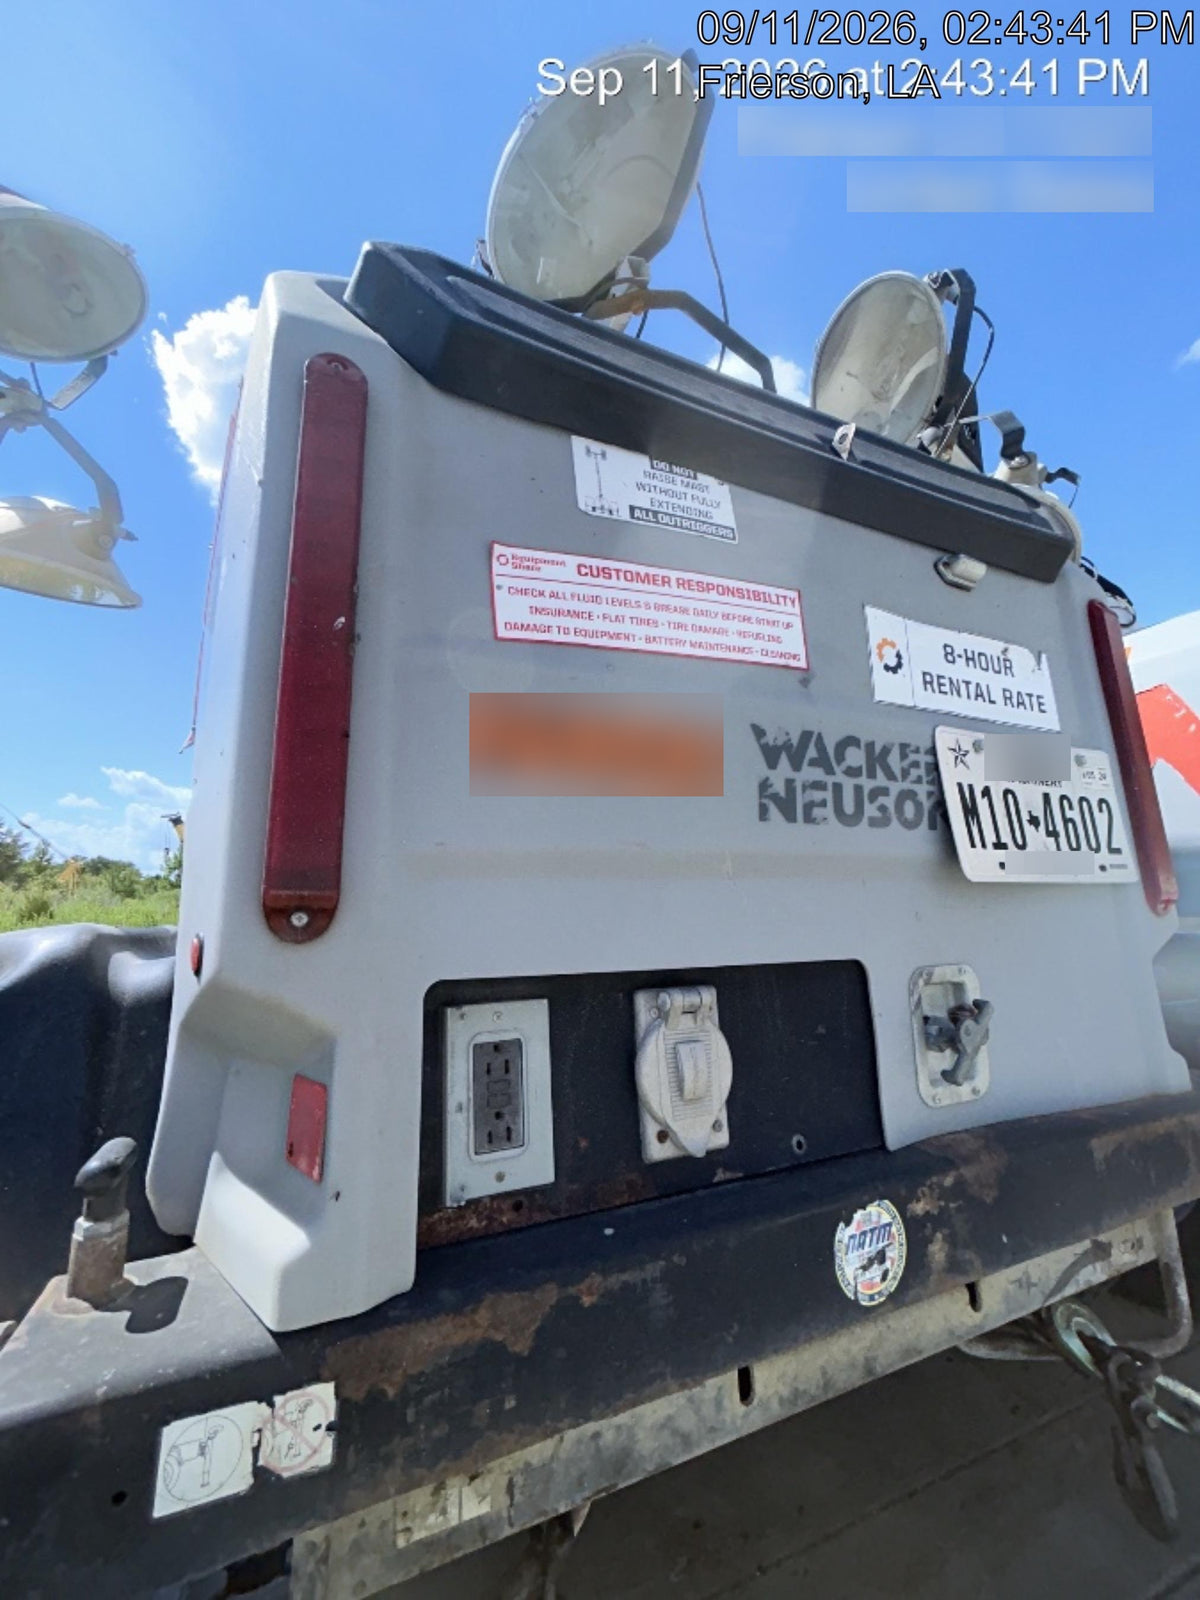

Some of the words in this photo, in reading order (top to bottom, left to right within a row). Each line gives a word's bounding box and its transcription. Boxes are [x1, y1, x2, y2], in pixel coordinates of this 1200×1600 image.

[636, 481, 688, 501] WITHOUT
[691, 494, 721, 509] FULLY
[643, 469, 677, 486] RAISE
[634, 509, 657, 522] ALL
[658, 514, 733, 539] OUTRIGGERS
[650, 497, 714, 520] EXTENDING
[508, 585, 546, 599] CHECK
[549, 591, 567, 601] ALL
[570, 593, 602, 605] FLUID
[605, 596, 641, 609] LEVELS
[693, 607, 719, 620] DAILY
[721, 612, 754, 625] BEFORE
[576, 563, 672, 588] CUSTOMER
[675, 577, 796, 608] RESPONSIBILITY
[504, 621, 553, 634] DAMAGE
[556, 625, 571, 636] TO
[574, 627, 636, 643] EQUIPMENT
[644, 635, 687, 648] BATTERY
[689, 640, 753, 655] MAINTENANCE
[760, 648, 801, 662] CLEANING
[529, 605, 594, 621] INSURANCE
[602, 612, 625, 625] FLAT
[629, 616, 659, 628] TIRES
[666, 619, 689, 631] TIRE
[691, 623, 730, 637] DAMAGE
[736, 629, 783, 644] REFUELING
[943, 643, 1015, 678] 8-HOUR
[922, 671, 997, 705] RENTAL
[1002, 687, 1048, 714] RATE
[956, 781, 1028, 850] M10
[1042, 792, 1122, 855] 4602
